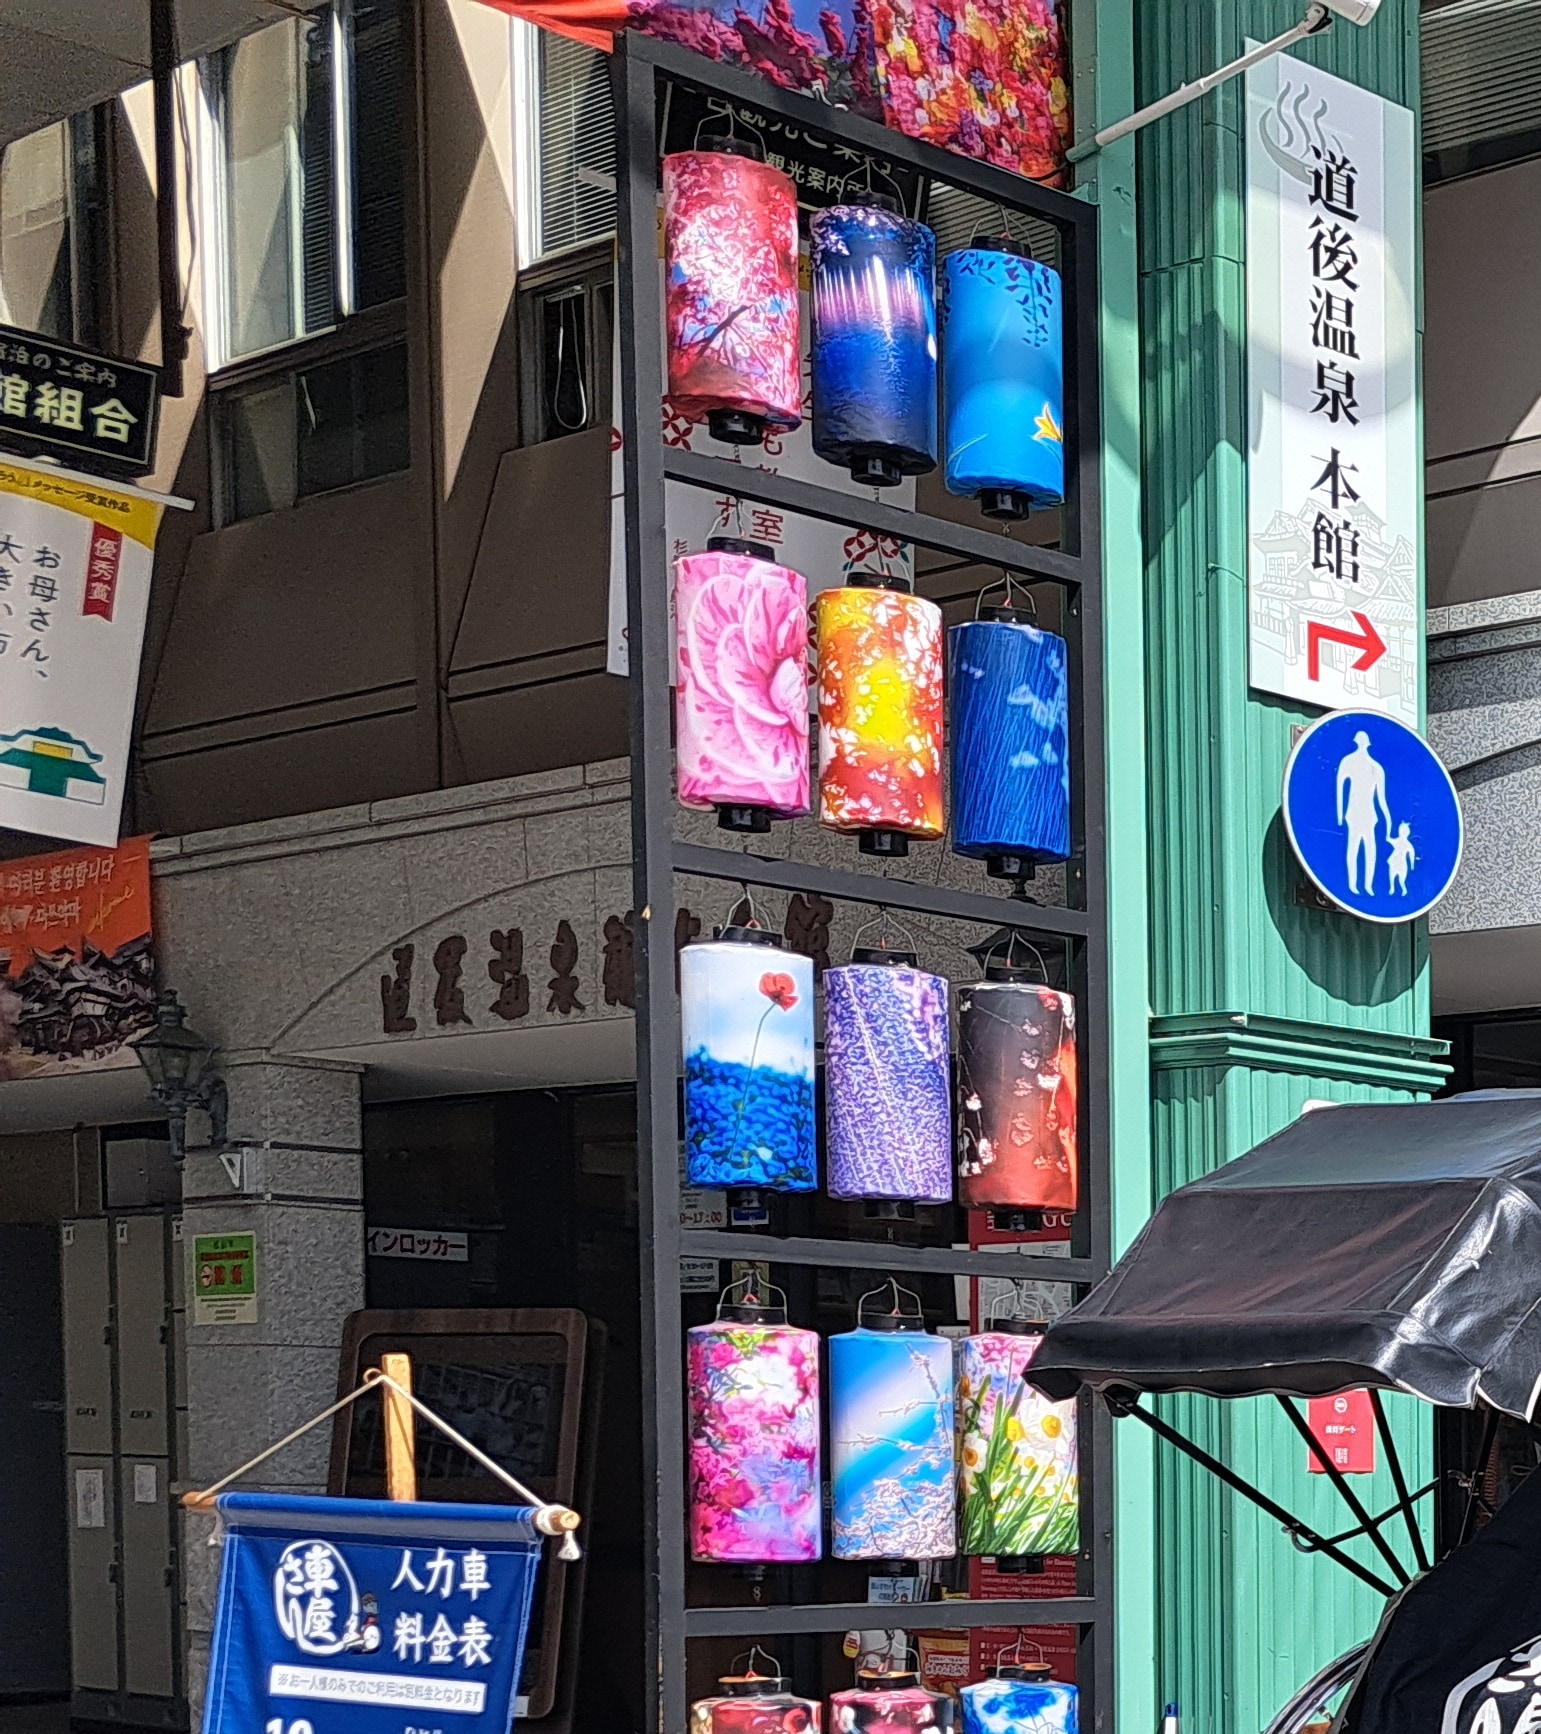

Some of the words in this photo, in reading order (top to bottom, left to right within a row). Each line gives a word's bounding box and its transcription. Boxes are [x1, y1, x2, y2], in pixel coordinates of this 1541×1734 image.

[1307, 145, 1361, 427] 道後温泉
[1309, 447, 1361, 584] 本館
[87, 538, 118, 604] 優秀賞
[390, 1546, 492, 1601] 人力車
[392, 1611, 494, 1668] 料金表
